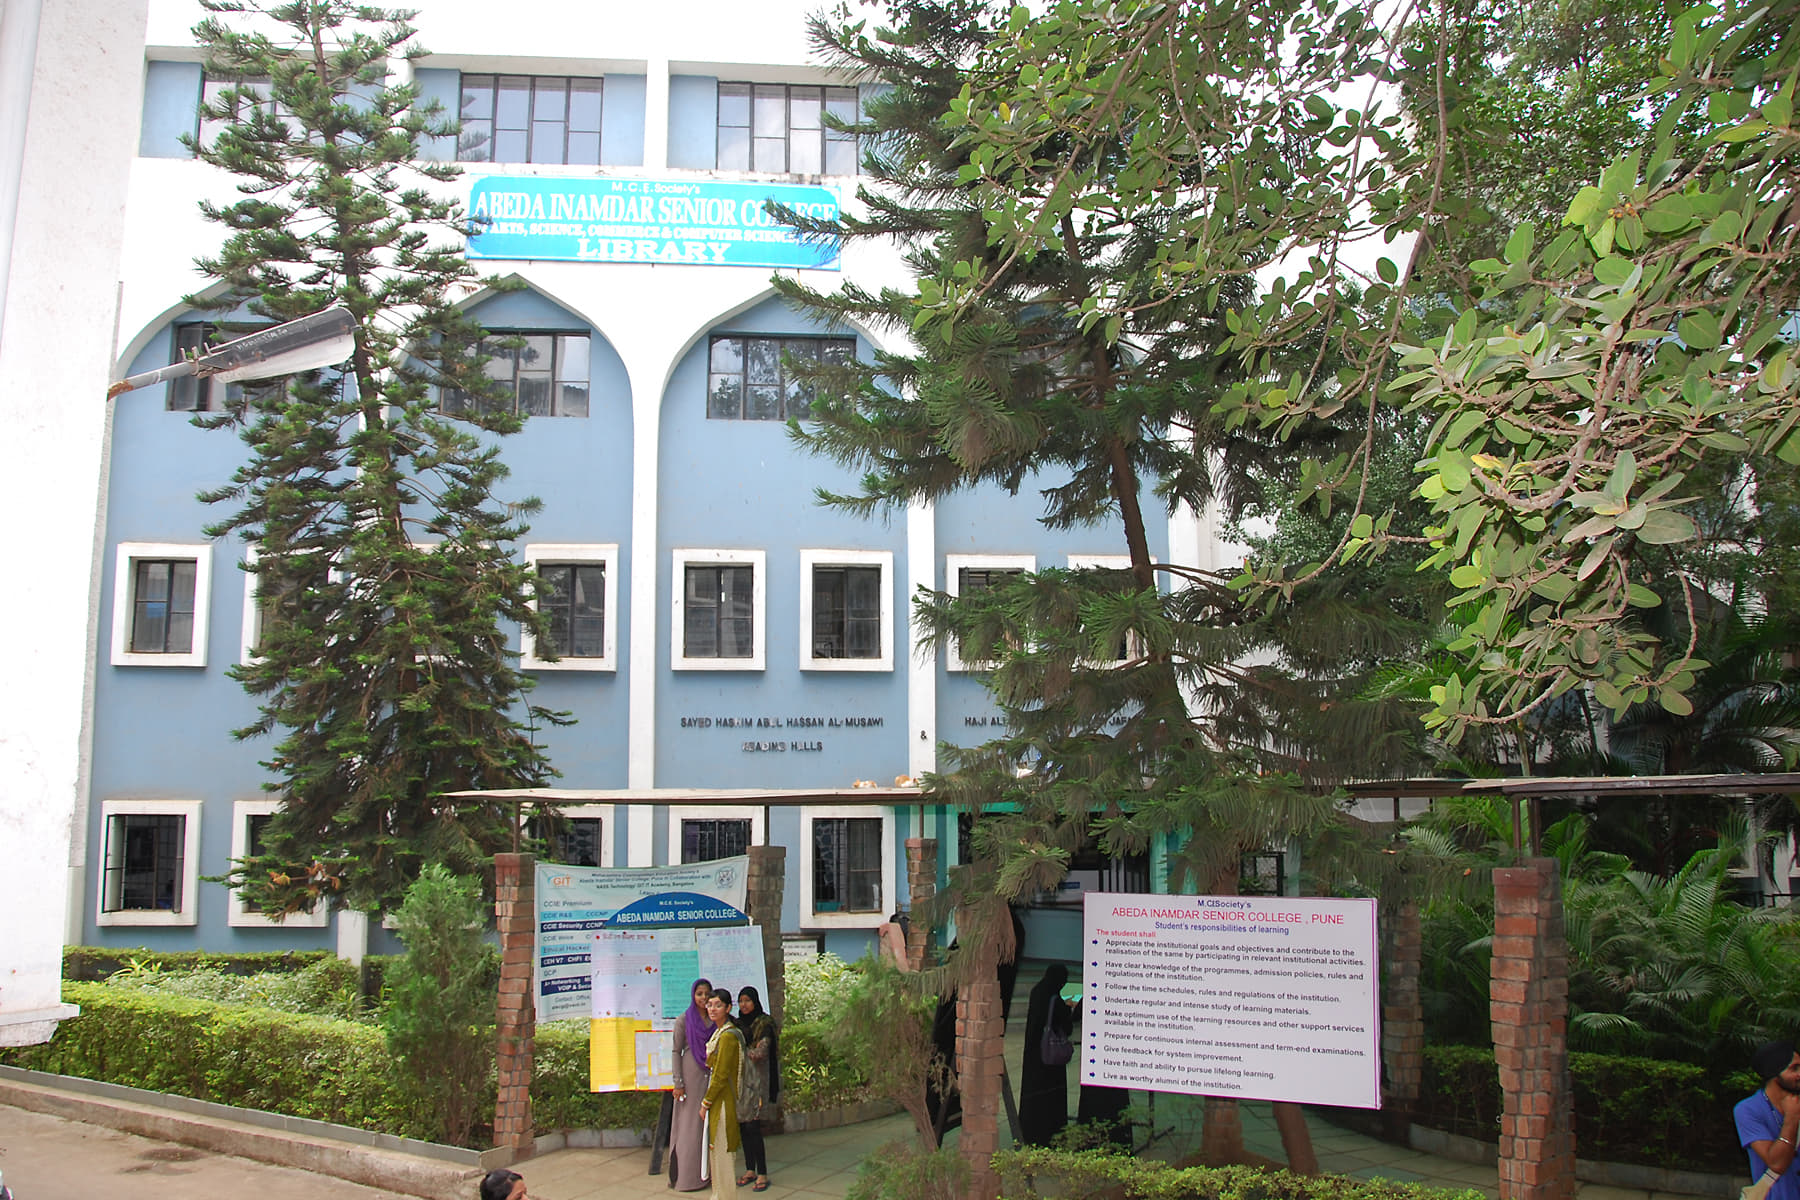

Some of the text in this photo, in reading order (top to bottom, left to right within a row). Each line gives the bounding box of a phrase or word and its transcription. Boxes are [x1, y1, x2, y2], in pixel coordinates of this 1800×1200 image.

[475, 192, 836, 230] ABEDA INAMDAR SENIOR COEGE
[661, 226, 673, 239] &
[674, 227, 743, 241] COMPUTER
[576, 238, 732, 262] LIBRARY
[680, 717, 712, 728] SAYED
[786, 717, 825, 728] HASSAN
[964, 716, 987, 728] HAJI
[919, 729, 927, 741] &
[791, 741, 823, 752] HALLS
[553, 875, 571, 887] GIT
[616, 908, 737, 923] ABEDA INAMDAR SENIOR COLLEGE
[1111, 907, 1343, 924] ABEDA INAMDAR SENIOR COLLEGE PUNE
[1155, 921, 1188, 929] Student's
[1190, 923, 1246, 933] responsibilities
[1258, 925, 1288, 935] learning
[1105, 939, 1142, 947] Appreciate
[1200, 943, 1219, 951] goals
[1236, 945, 1274, 953] objectives
[1184, 951, 1192, 959] by
[1195, 952, 1240, 961] participating
[1142, 963, 1180, 972] knowledge
[1105, 970, 1143, 979] regulations
[1234, 991, 1275, 999] regulations
[1141, 999, 1165, 1007] regular
[1211, 1003, 1230, 1011] study
[1242, 1005, 1272, 1013] learning
[1124, 1011, 1154, 1020] optimum
[1193, 1016, 1222, 1024] learning
[1301, 1022, 1329, 1031] support
[1332, 1024, 1364, 1032] services
[1104, 1032, 1130, 1041] Prepare
[1144, 1035, 1183, 1043] continuous
[1214, 1040, 1258, 1048] assessment
[1276, 1044, 1310, 1052] term-end
[1166, 1050, 1191, 1059] system
[1154, 1063, 1176, 1072] ability
[1214, 1068, 1241, 1077] lifelong
[1129, 1075, 1153, 1083] worthy
